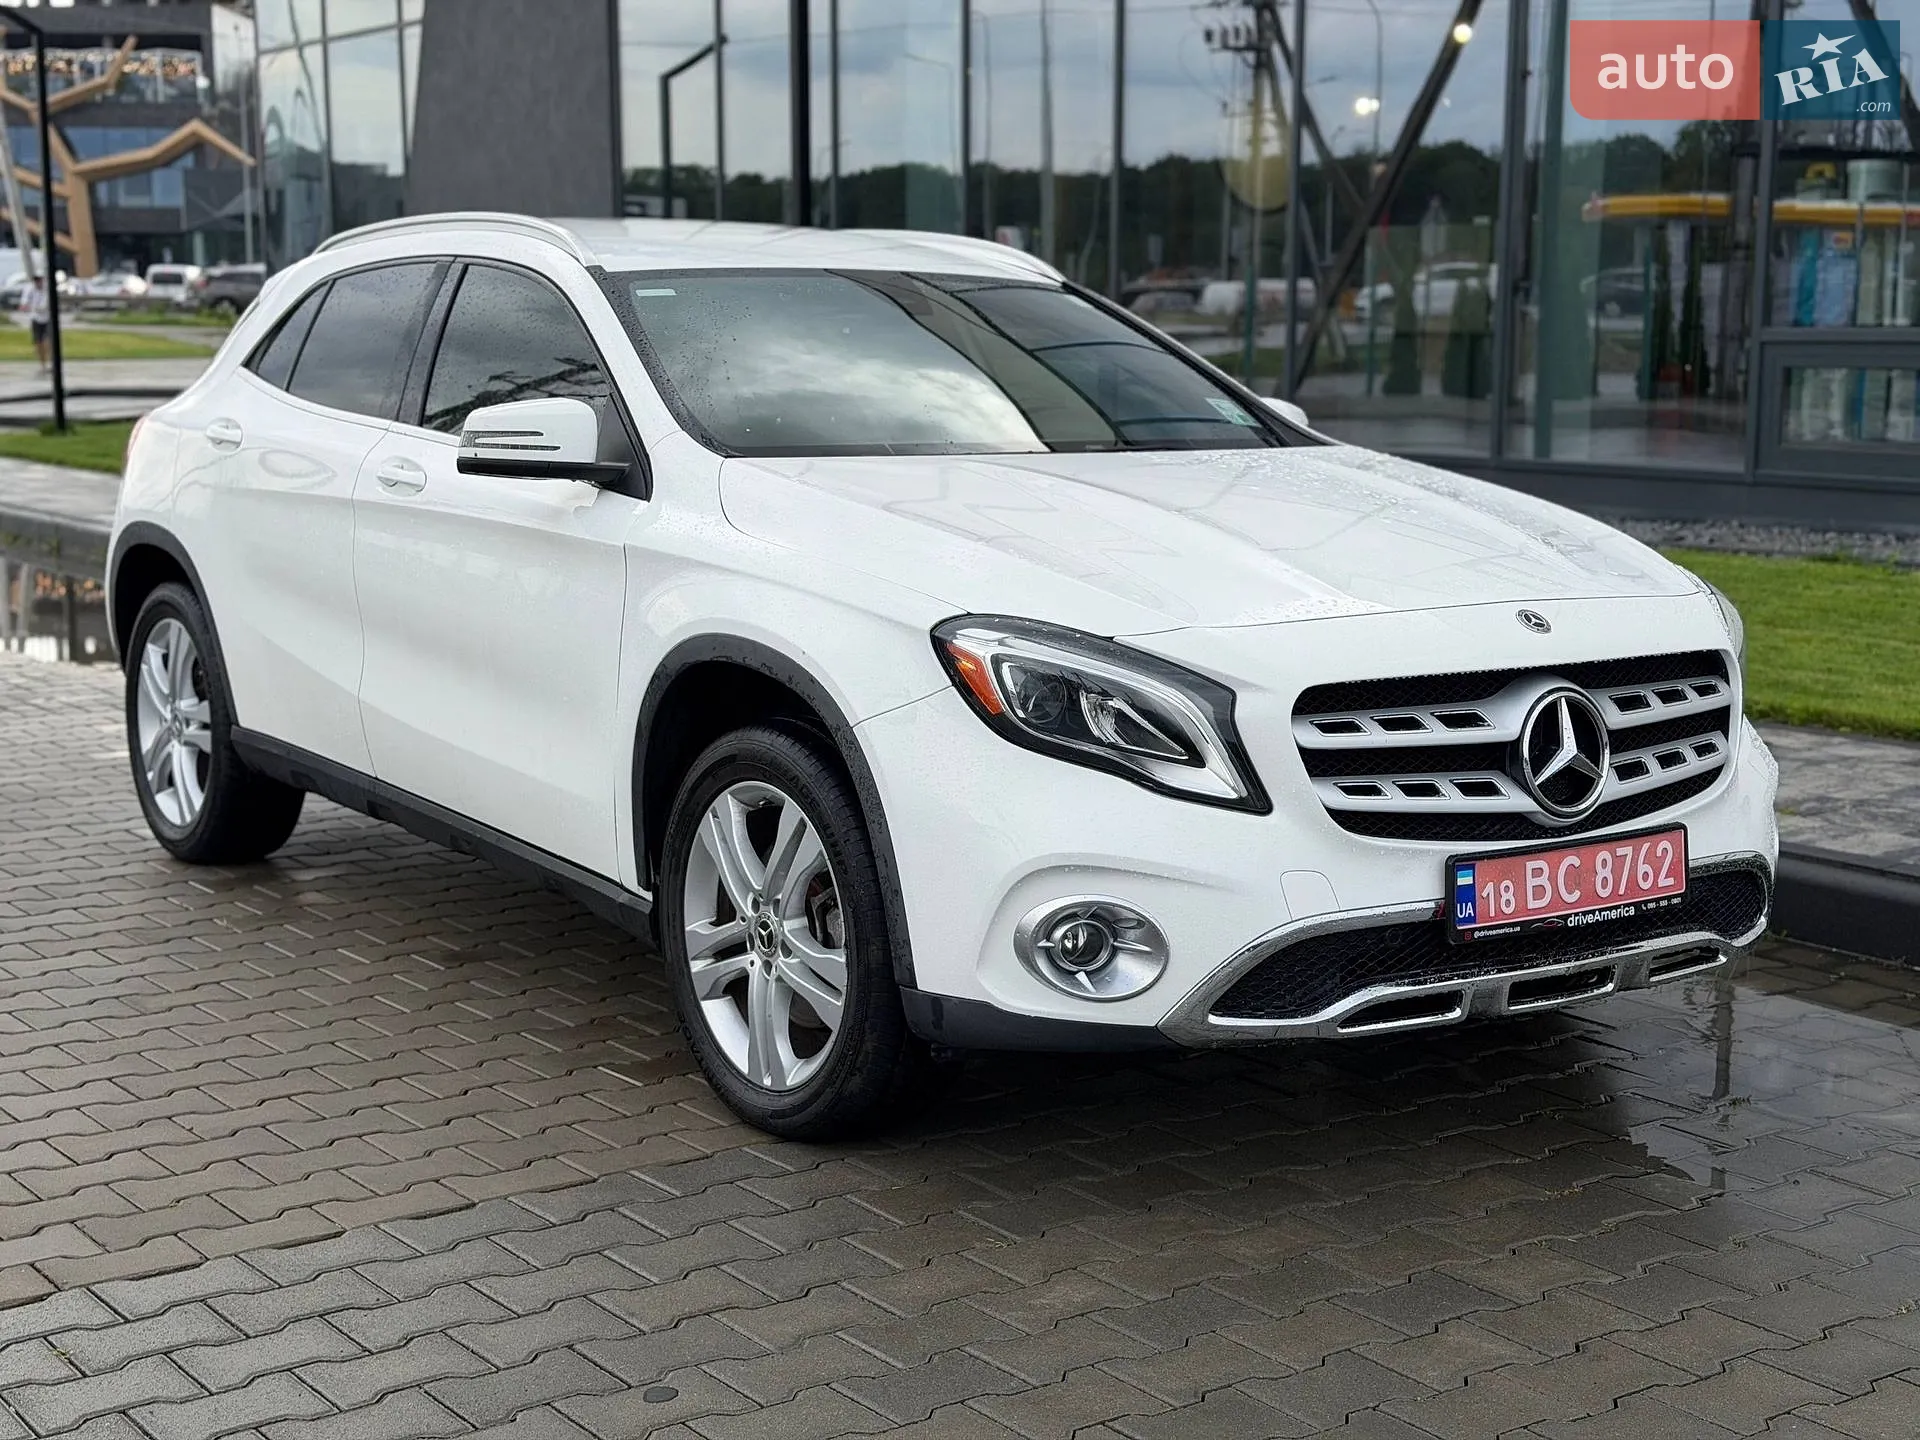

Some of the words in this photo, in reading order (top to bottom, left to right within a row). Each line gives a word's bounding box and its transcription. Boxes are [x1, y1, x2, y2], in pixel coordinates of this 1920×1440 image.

[1481, 879, 1516, 917] 18
[1525, 854, 1582, 910] BC
[1595, 839, 1676, 899] 8762
[1457, 902, 1474, 918] UA
[1567, 905, 1635, 927] driveAmerica
